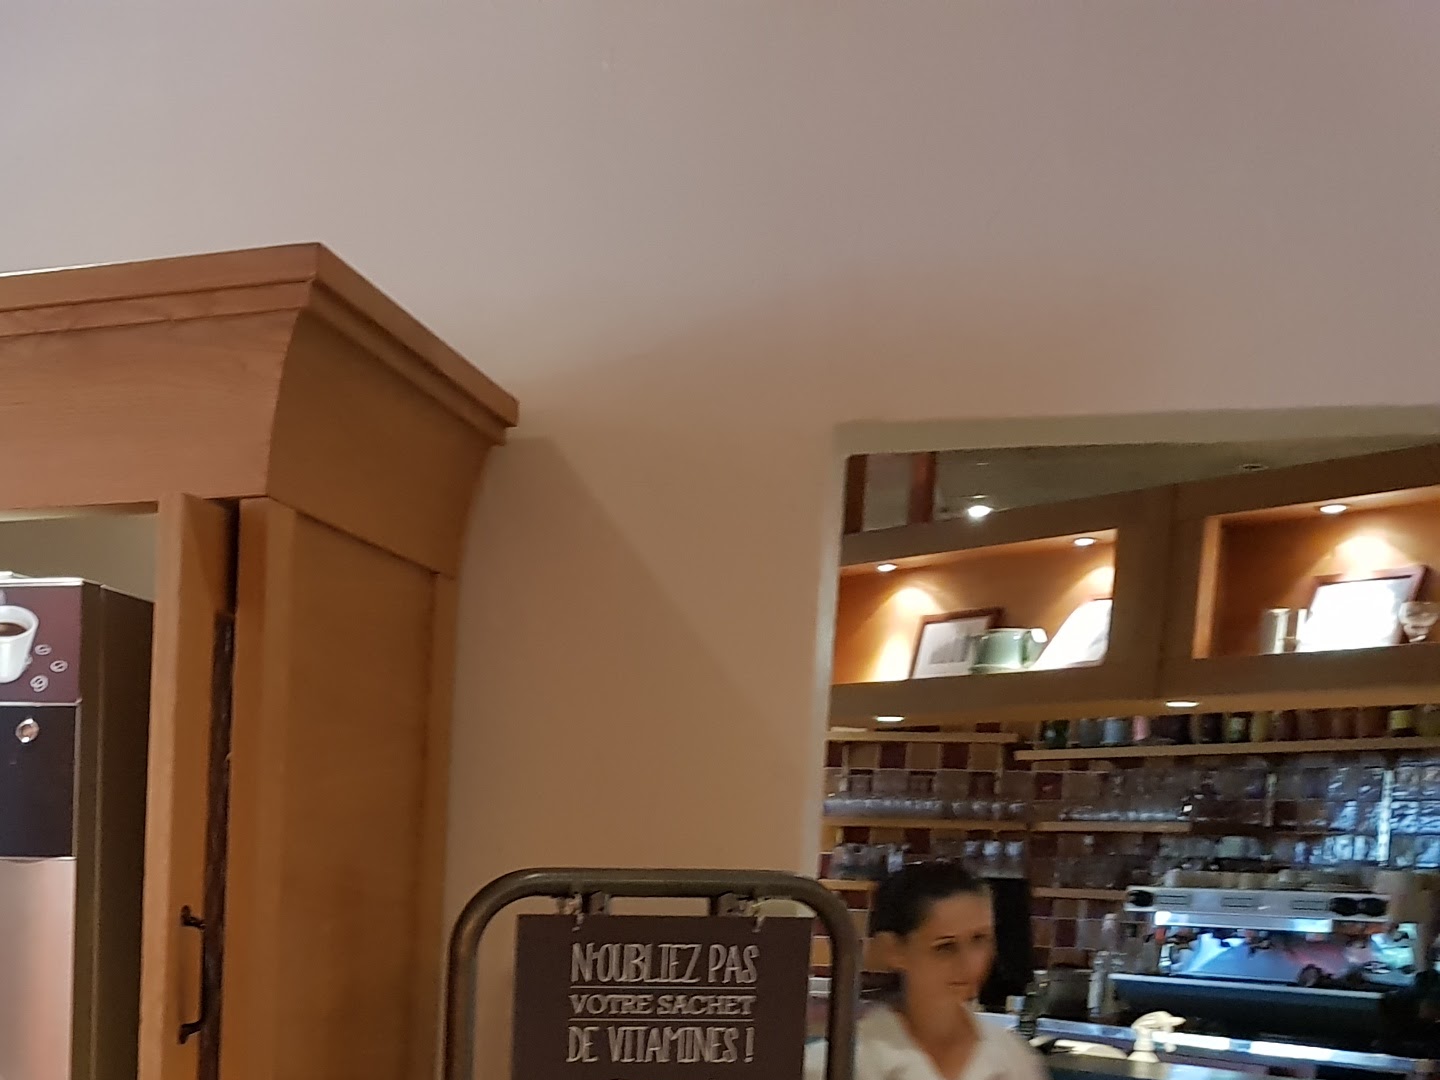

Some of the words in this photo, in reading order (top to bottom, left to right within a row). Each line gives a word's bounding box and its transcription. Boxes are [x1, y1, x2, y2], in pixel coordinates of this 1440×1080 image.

[570, 943, 703, 983] N'OUBLIEZ
[707, 943, 760, 984] PAS
[569, 994, 654, 1015] VOTRE
[656, 994, 757, 1016] SACHET
[565, 1027, 600, 1063] DE
[607, 1026, 739, 1064] VITAMINES
